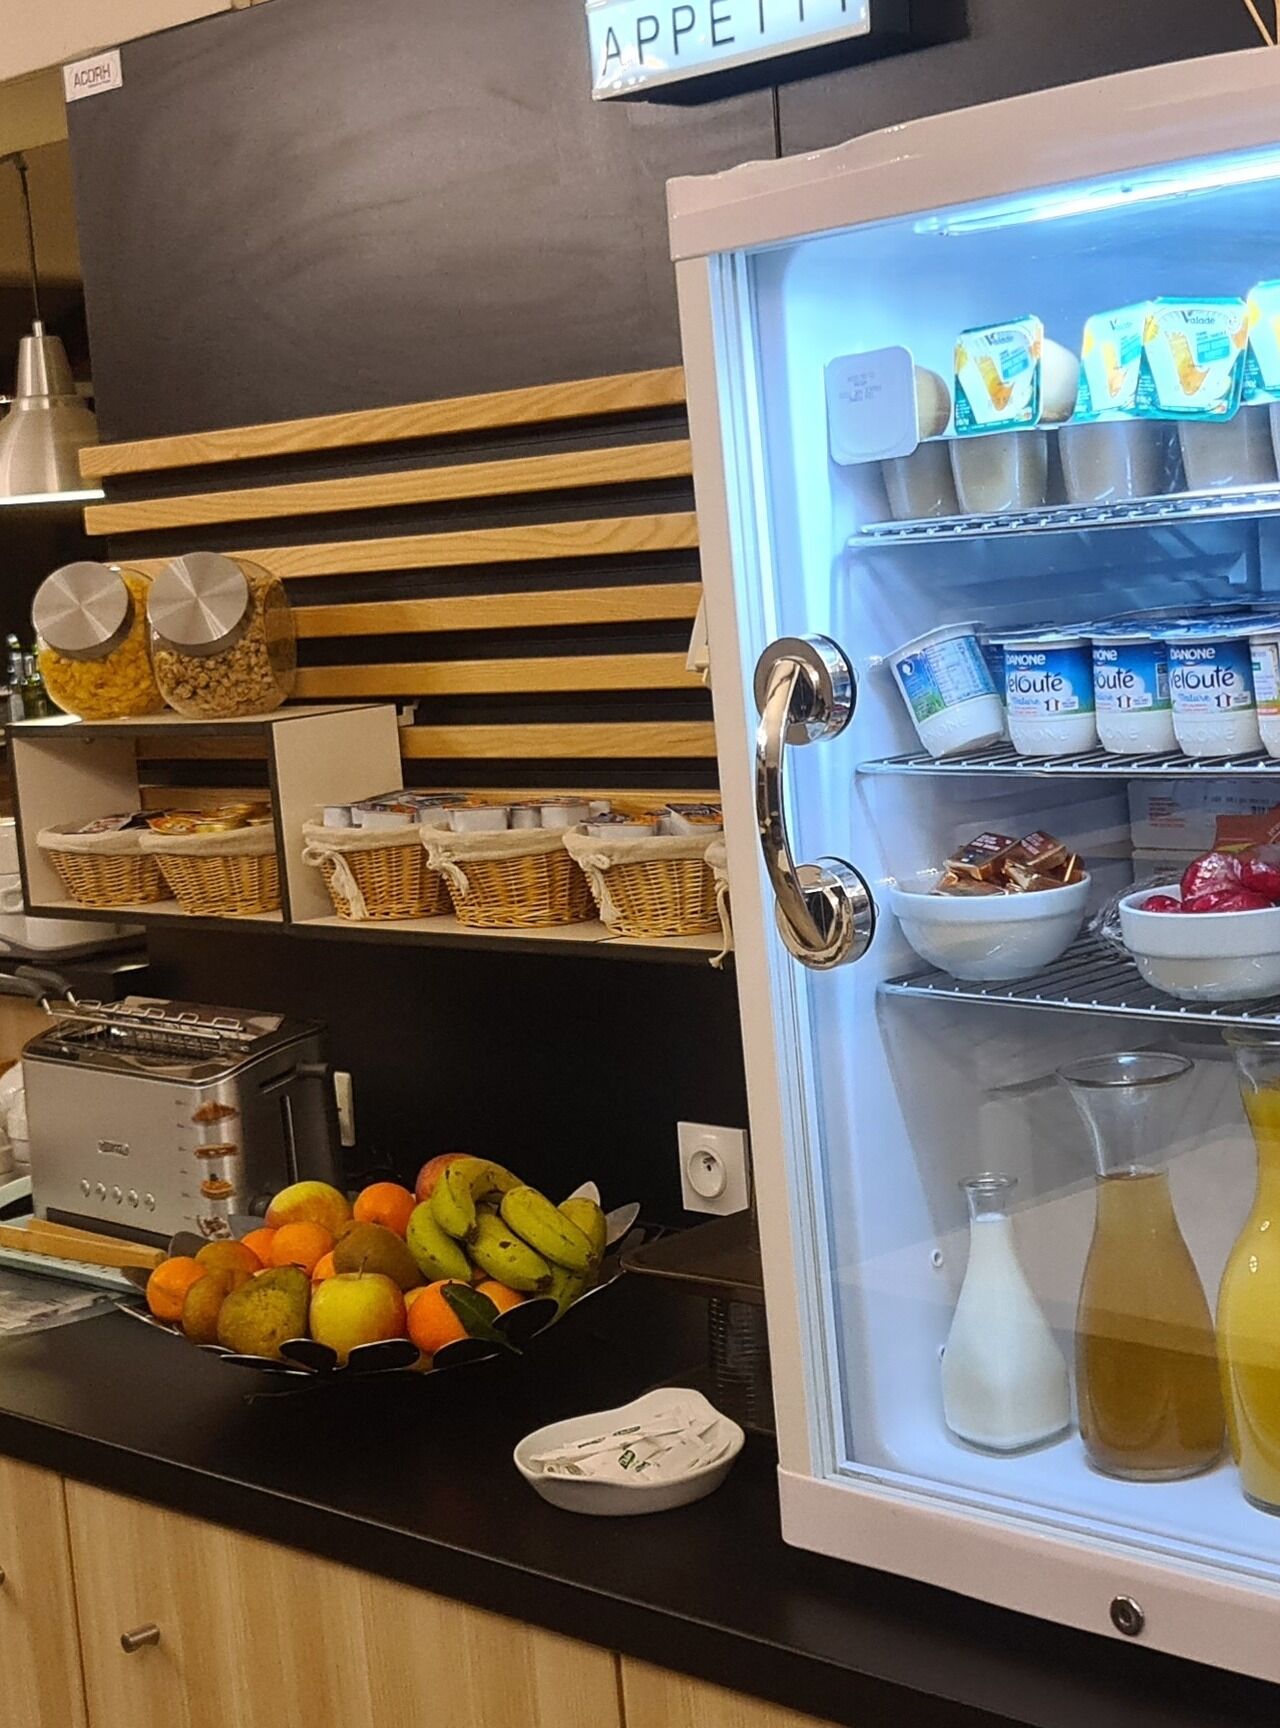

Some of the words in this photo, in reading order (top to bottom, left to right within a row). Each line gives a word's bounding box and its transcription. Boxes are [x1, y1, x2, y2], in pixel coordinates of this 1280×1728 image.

[602, 0, 847, 76] APPET
[1181, 310, 1215, 324] Valade
[1170, 648, 1215, 660] DANONE
